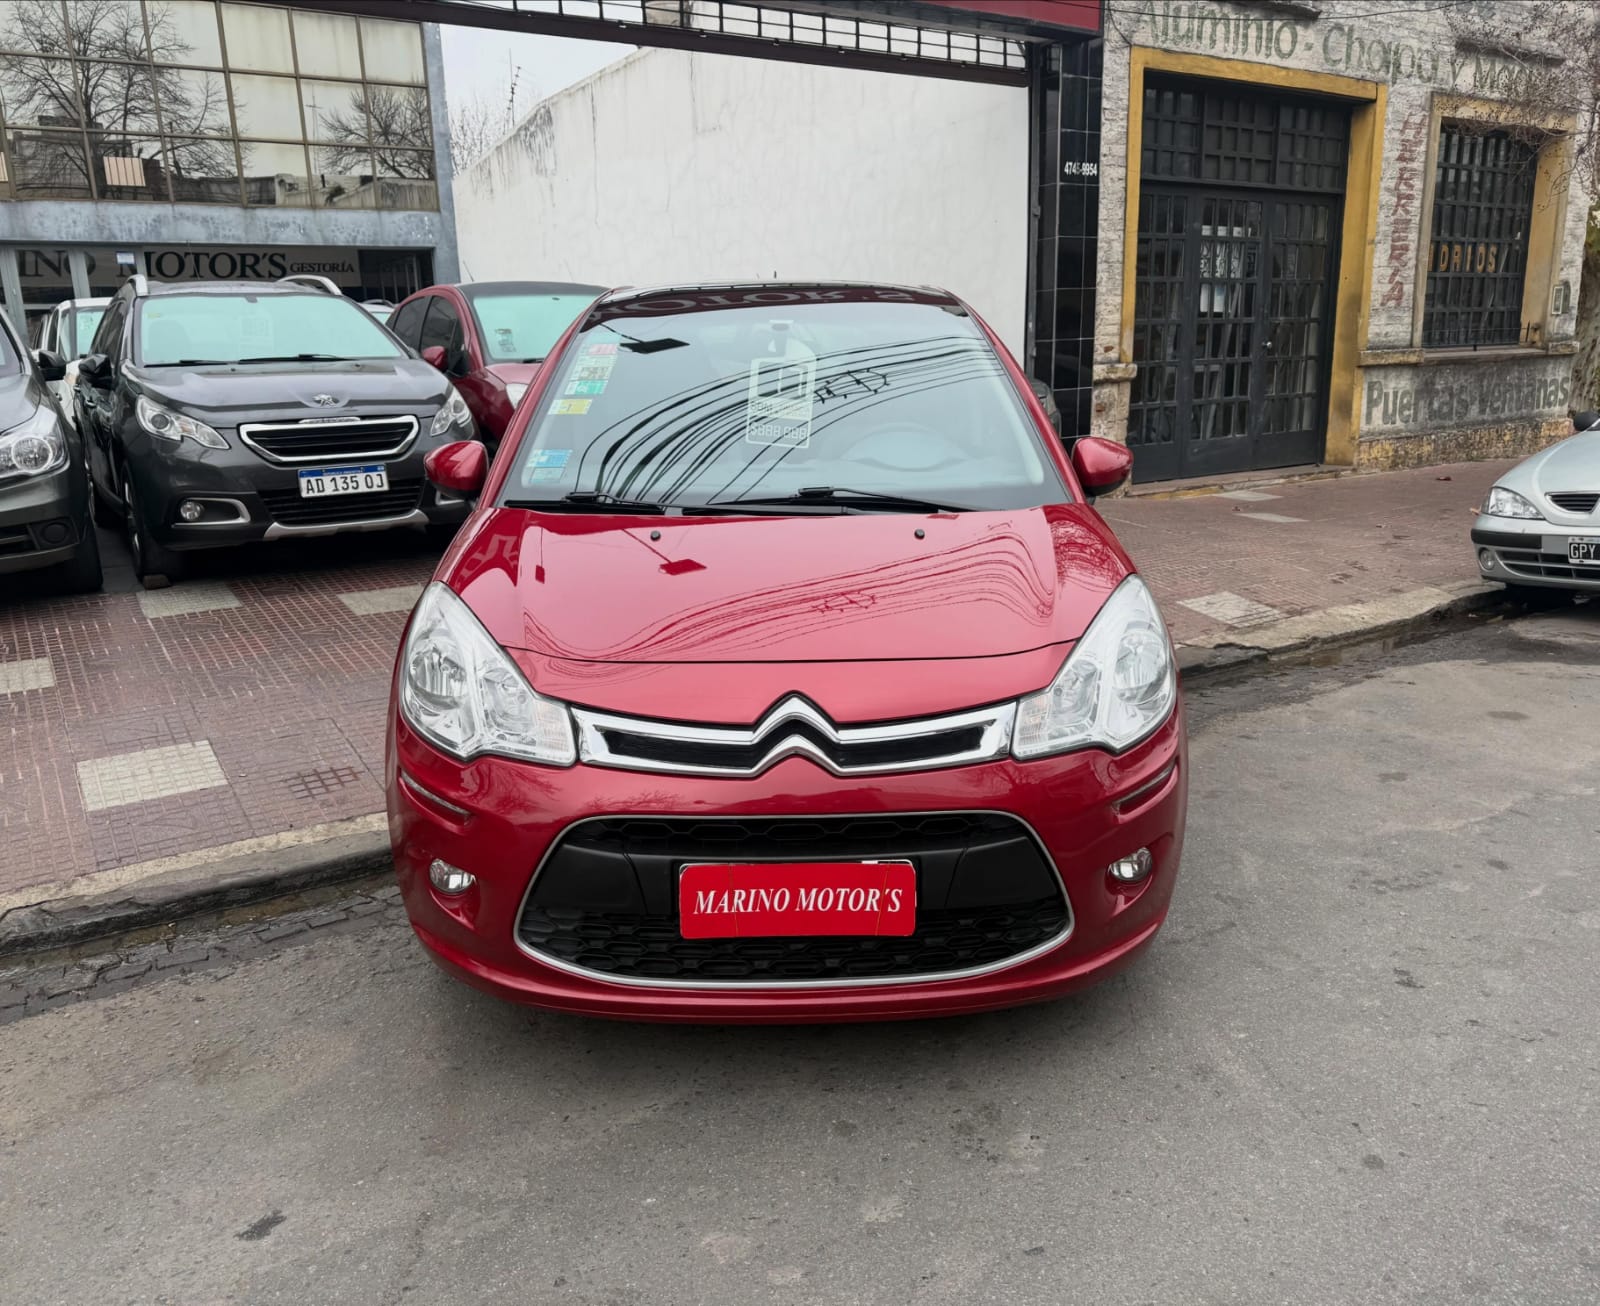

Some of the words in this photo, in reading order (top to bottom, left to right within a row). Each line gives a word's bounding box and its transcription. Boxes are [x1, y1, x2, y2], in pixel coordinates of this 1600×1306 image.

[1143, 1, 1298, 59] Aluminio
[1323, 22, 1440, 84] Chapa
[1380, 114, 1428, 307] HERRERIA
[1365, 380, 1469, 425] Puertas
[306, 478, 326, 495] AD
[330, 475, 360, 492] 135
[364, 473, 385, 490] OJ
[1570, 543, 1596, 560] GPY
[693, 887, 790, 914] MARINO
[795, 887, 903, 912] MOTOR'S
